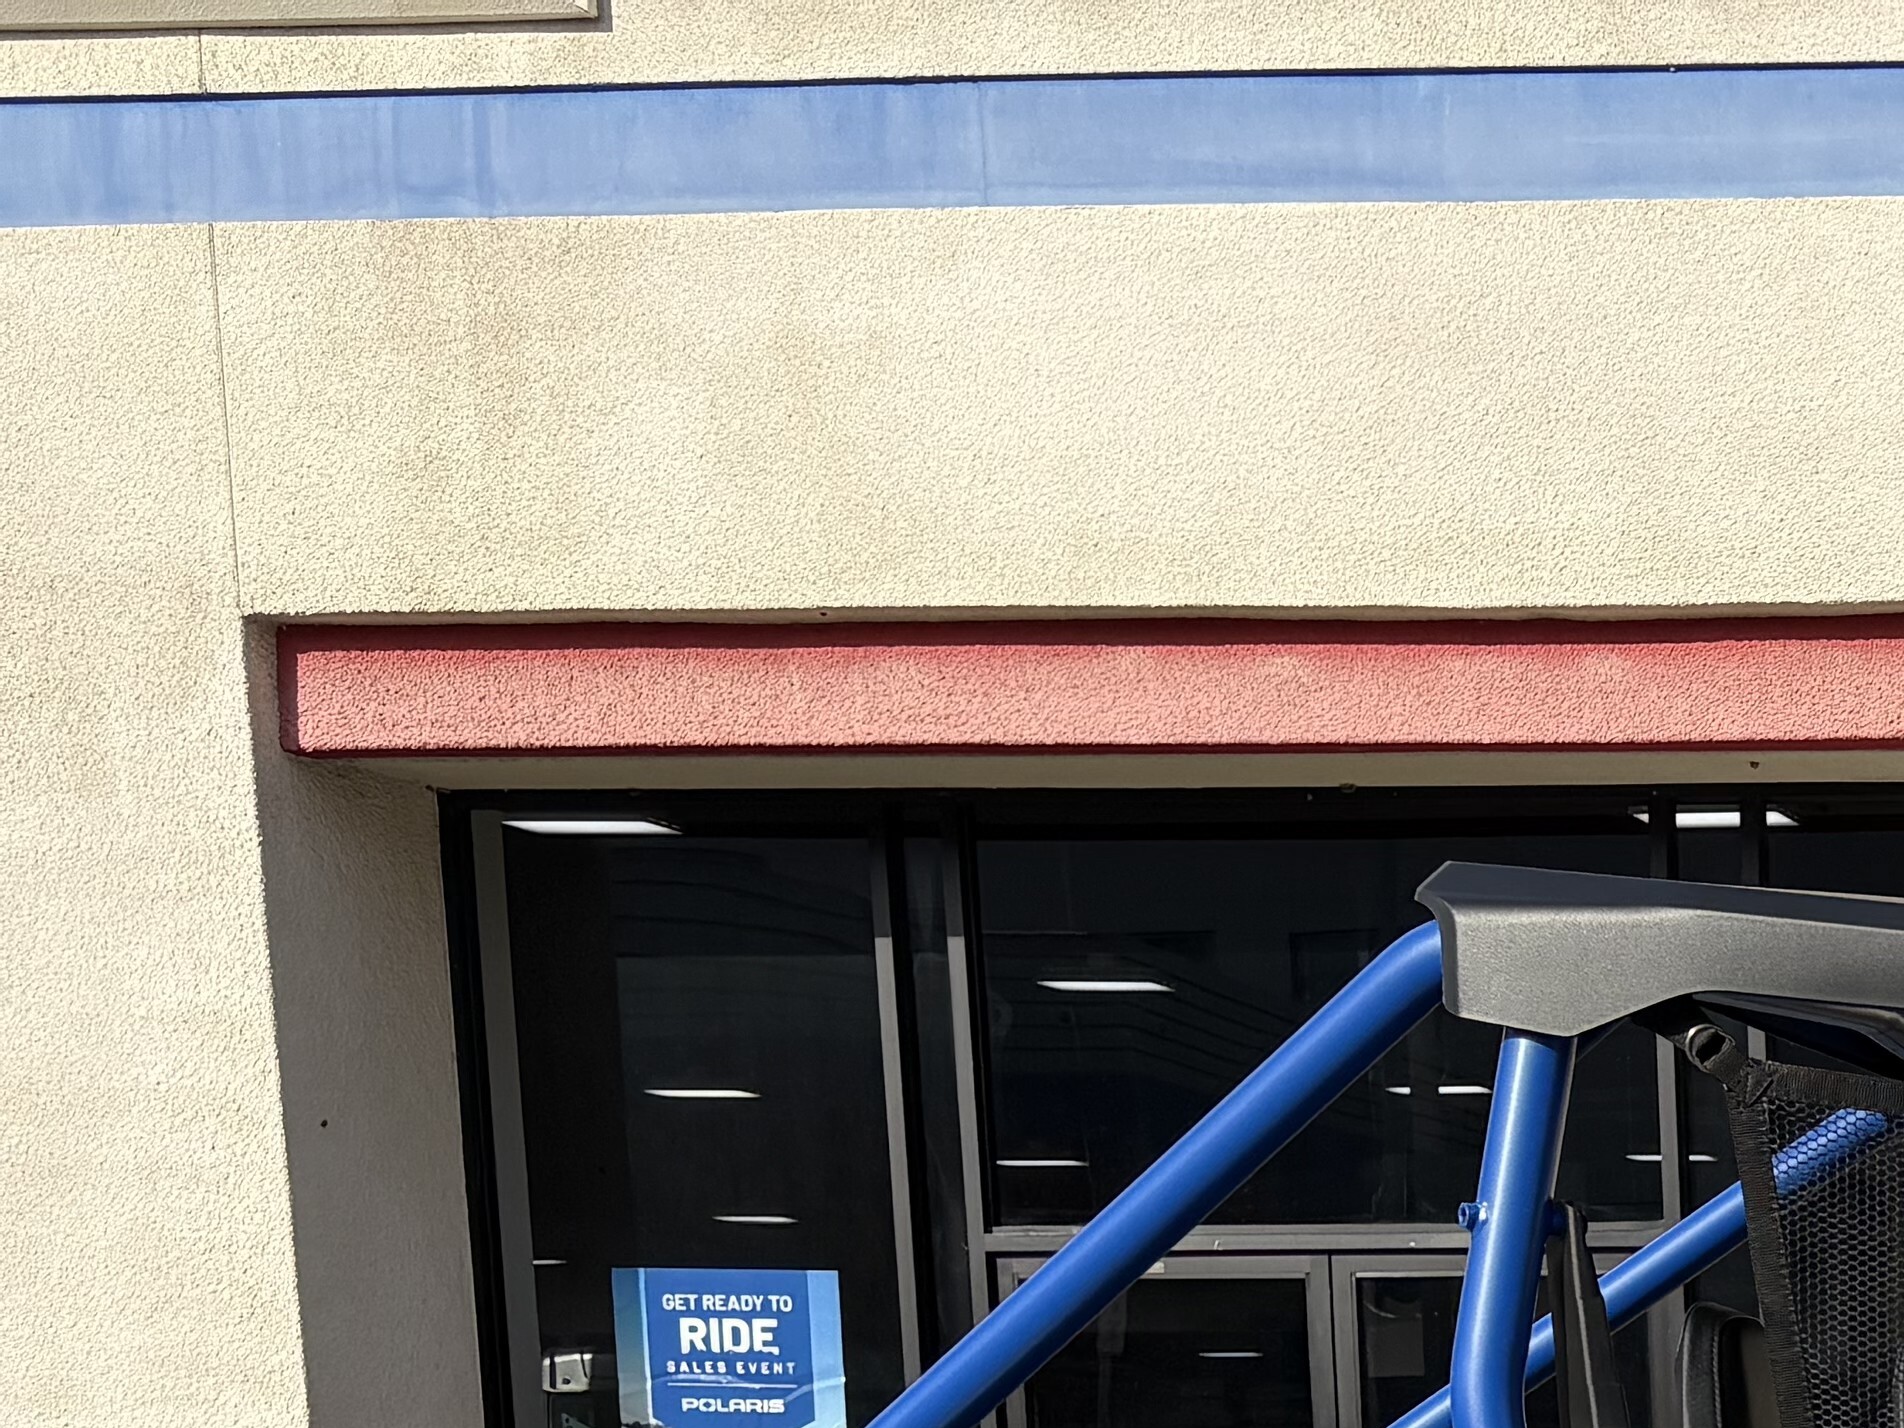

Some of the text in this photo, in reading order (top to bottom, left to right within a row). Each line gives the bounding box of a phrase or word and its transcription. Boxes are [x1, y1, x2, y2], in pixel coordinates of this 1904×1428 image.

[662, 1293, 793, 1312] GET READY TO
[679, 1317, 780, 1355] RIDE
[666, 1360, 796, 1375] SALES EVENT
[681, 1397, 785, 1413] POLARIS
